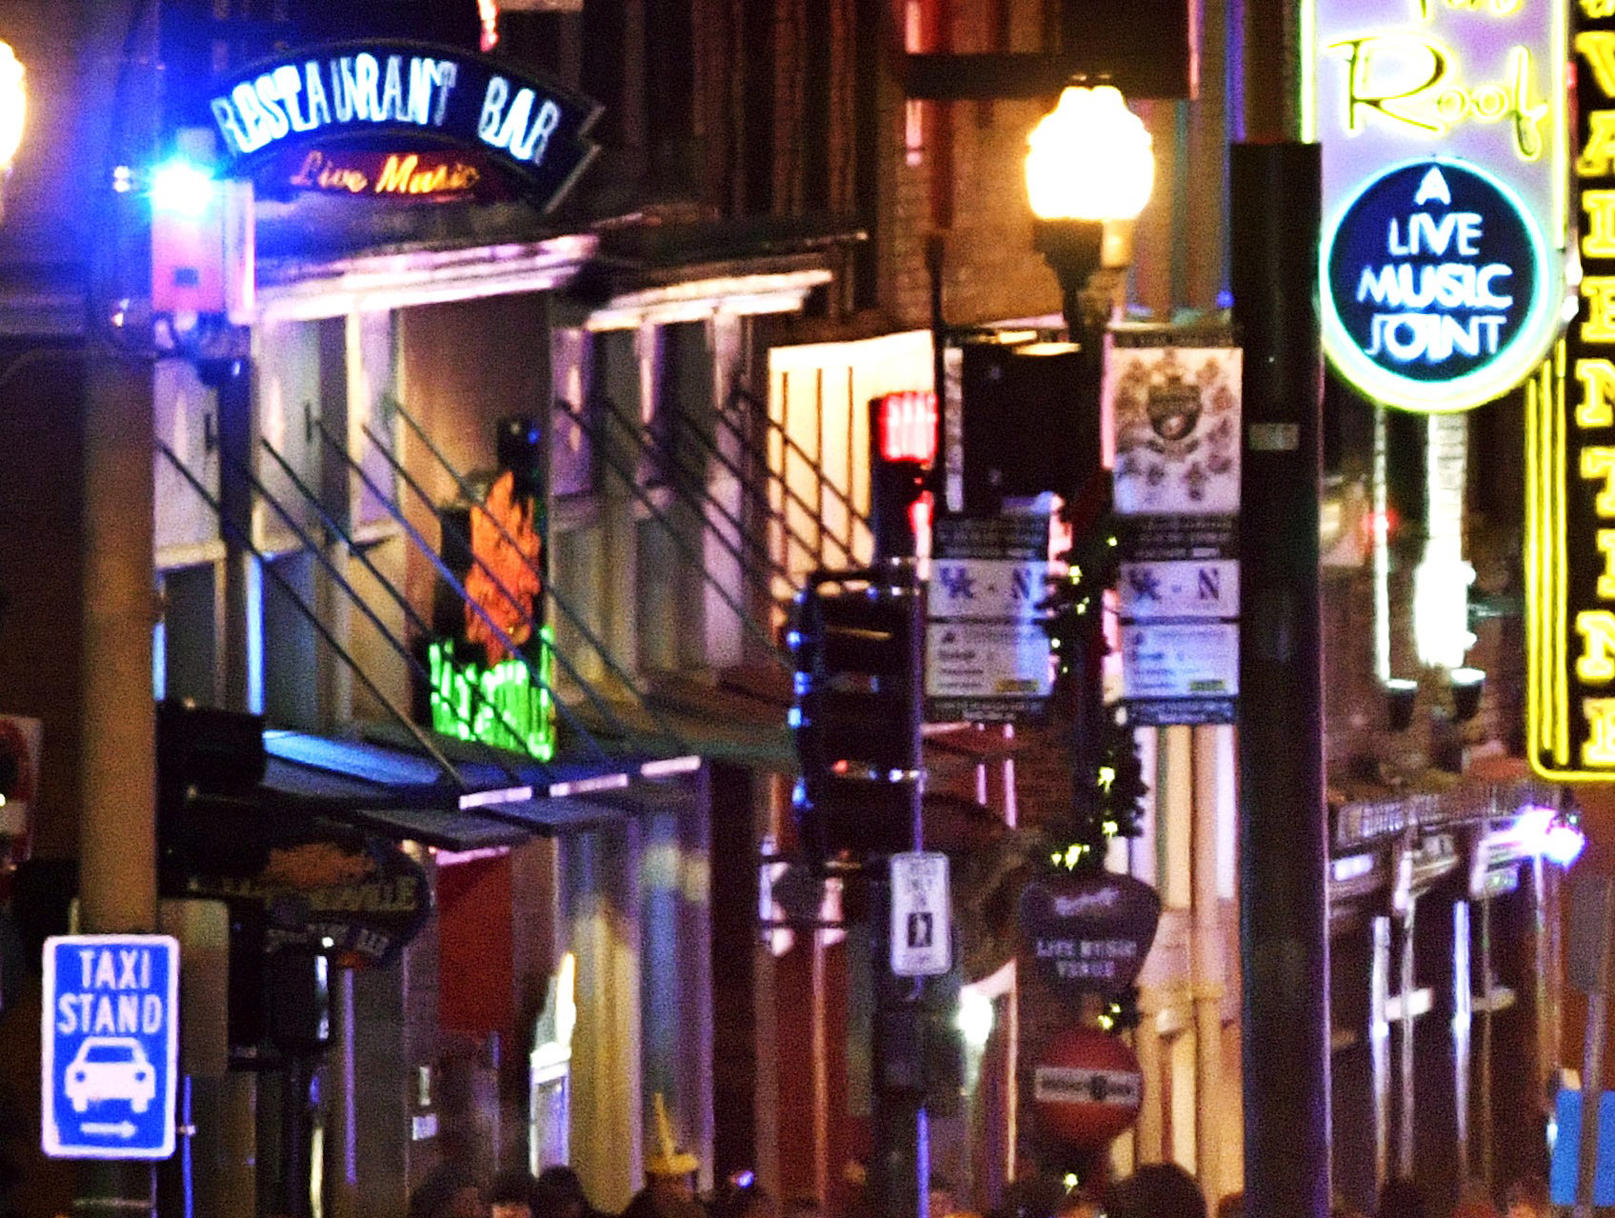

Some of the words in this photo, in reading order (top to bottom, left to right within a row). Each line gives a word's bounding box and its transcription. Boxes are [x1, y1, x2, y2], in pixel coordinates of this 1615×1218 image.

[211, 53, 458, 158] RESTAURANT
[477, 76, 562, 166] BAR
[1320, 34, 1549, 162] Roof
[375, 154, 480, 194] Music
[1413, 166, 1451, 206] A
[1387, 211, 1483, 257] LIVE
[1356, 262, 1514, 311] MUSIC
[1365, 312, 1508, 365] JOINT
[79, 949, 151, 990] TAXI
[57, 992, 163, 1035] STAND
